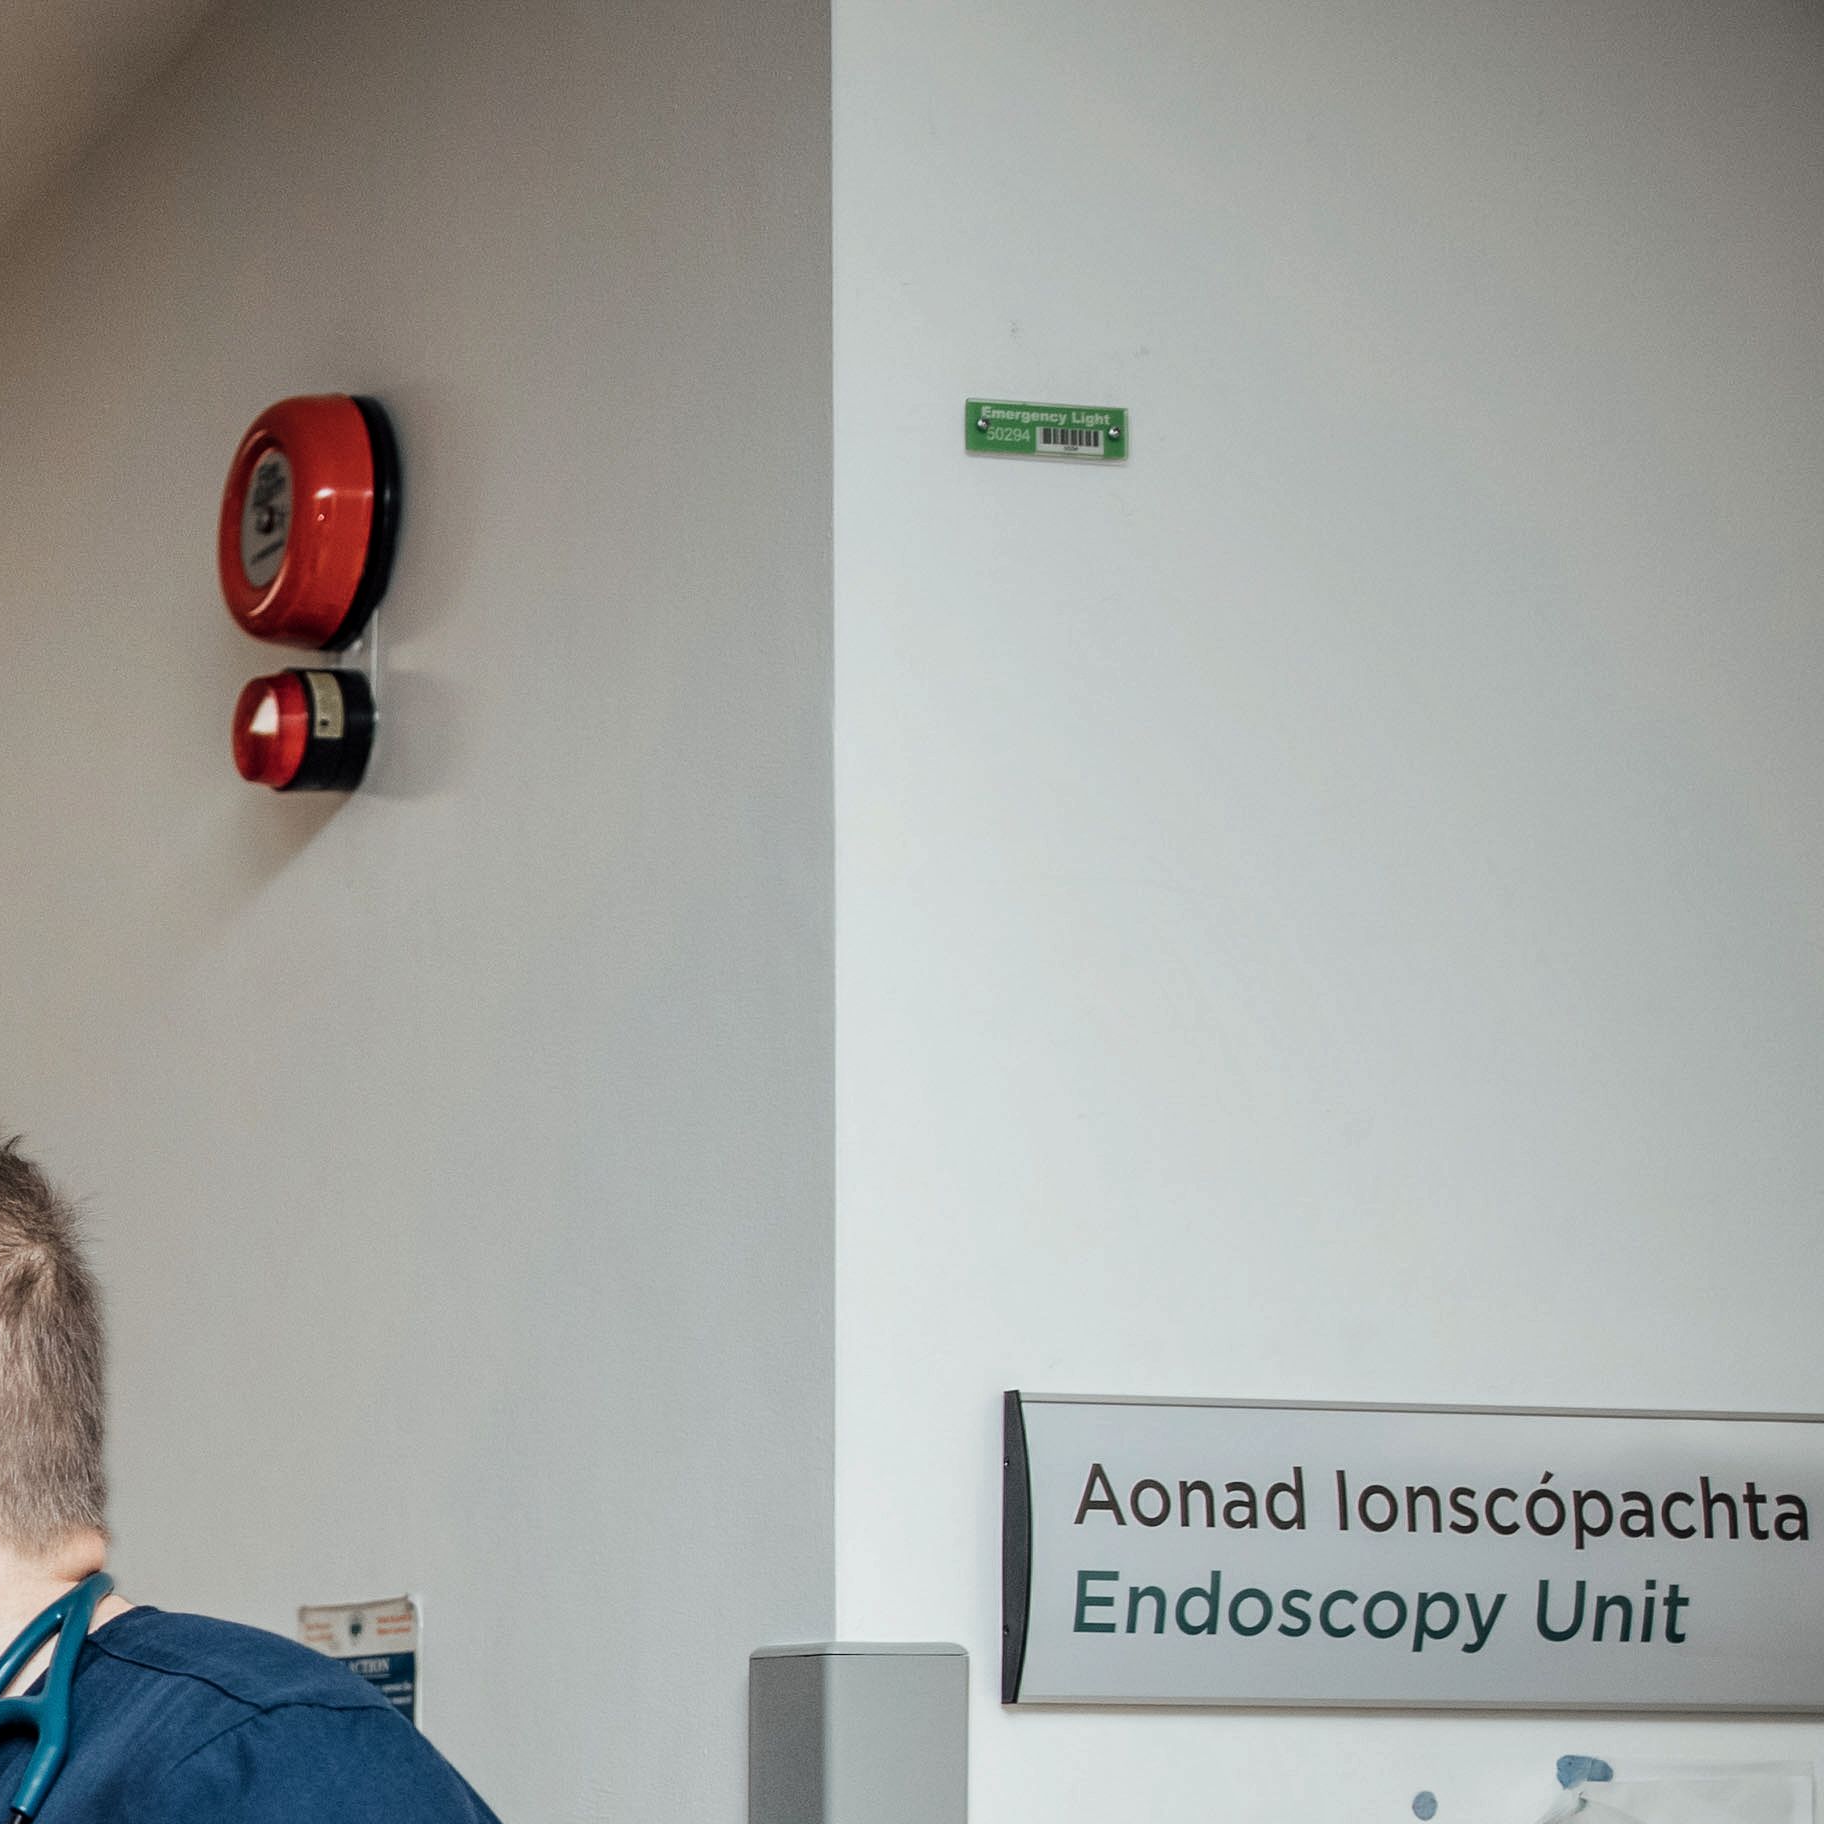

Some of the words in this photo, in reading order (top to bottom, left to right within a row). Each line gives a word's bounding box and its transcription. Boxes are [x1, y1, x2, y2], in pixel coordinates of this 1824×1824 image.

[981, 405, 1068, 426] Emergency
[1071, 410, 1112, 427] Light
[1074, 1463, 1306, 1531] Aonad
[1336, 1469, 1809, 1549] Ionscópachta
[1071, 1568, 1507, 1653] Endoscopy
[1536, 1577, 1691, 1645] Unit
